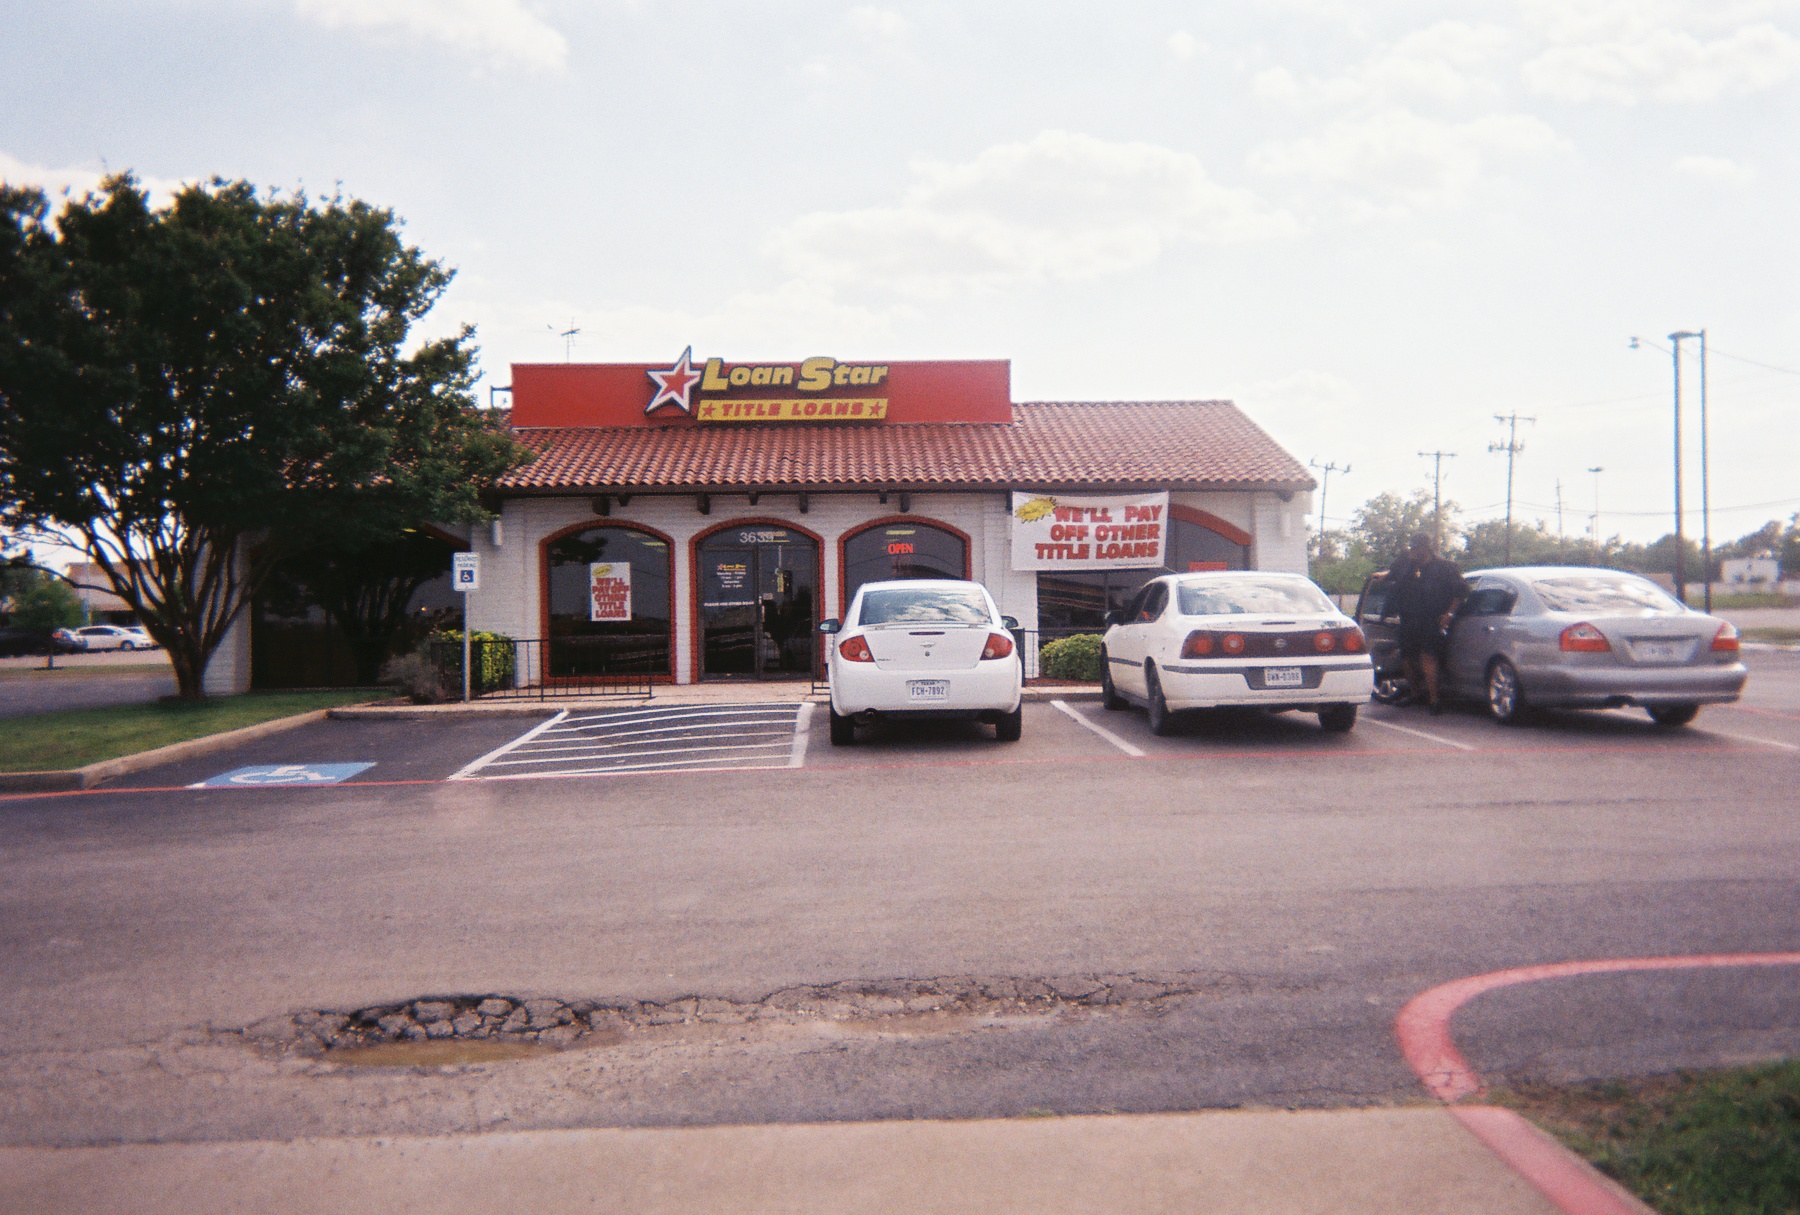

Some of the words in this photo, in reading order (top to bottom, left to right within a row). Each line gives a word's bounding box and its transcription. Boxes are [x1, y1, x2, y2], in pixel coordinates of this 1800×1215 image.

[701, 357, 794, 391] Loan
[797, 356, 889, 391] Star
[722, 403, 782, 417] TITLE
[790, 402, 864, 416] LOANS
[1054, 506, 1113, 523] WE'LL
[1125, 505, 1163, 522] PAY
[1050, 524, 1089, 541] OFF
[1095, 524, 1161, 541] OTHER
[887, 543, 914, 554] OPEN
[1035, 543, 1090, 559] TITLE
[1095, 542, 1159, 559] LOANS
[595, 610, 627, 618] LOANS
[598, 602, 625, 610] TITLE
